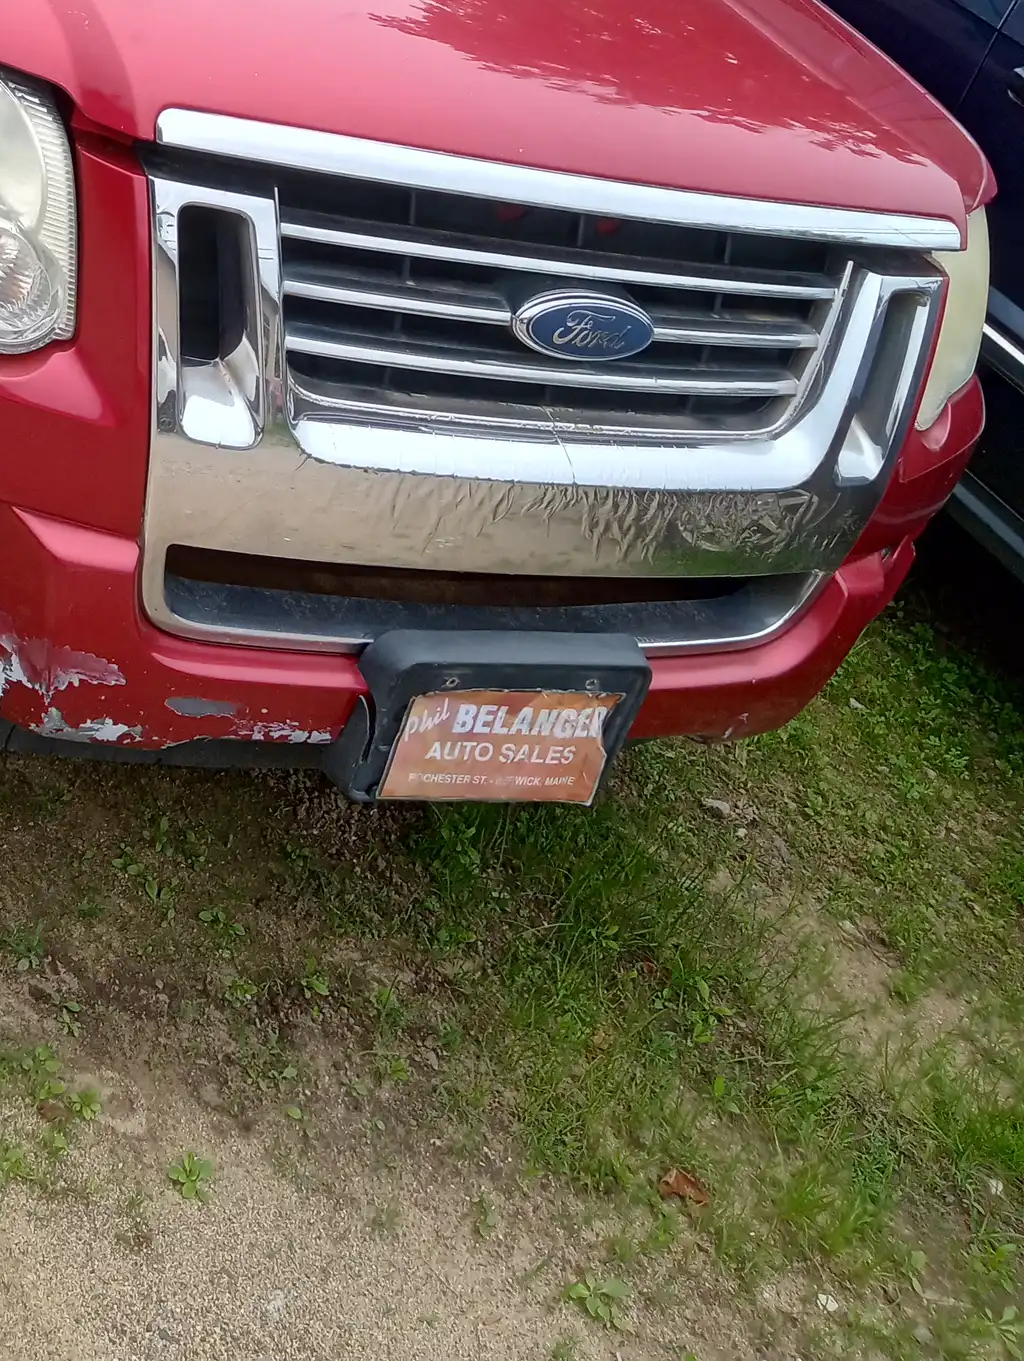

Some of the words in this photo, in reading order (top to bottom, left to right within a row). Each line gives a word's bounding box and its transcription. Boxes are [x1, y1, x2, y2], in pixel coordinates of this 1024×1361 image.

[552, 309, 632, 350] Ford
[424, 741, 494, 763] AUTO
[498, 743, 577, 765] SALES
